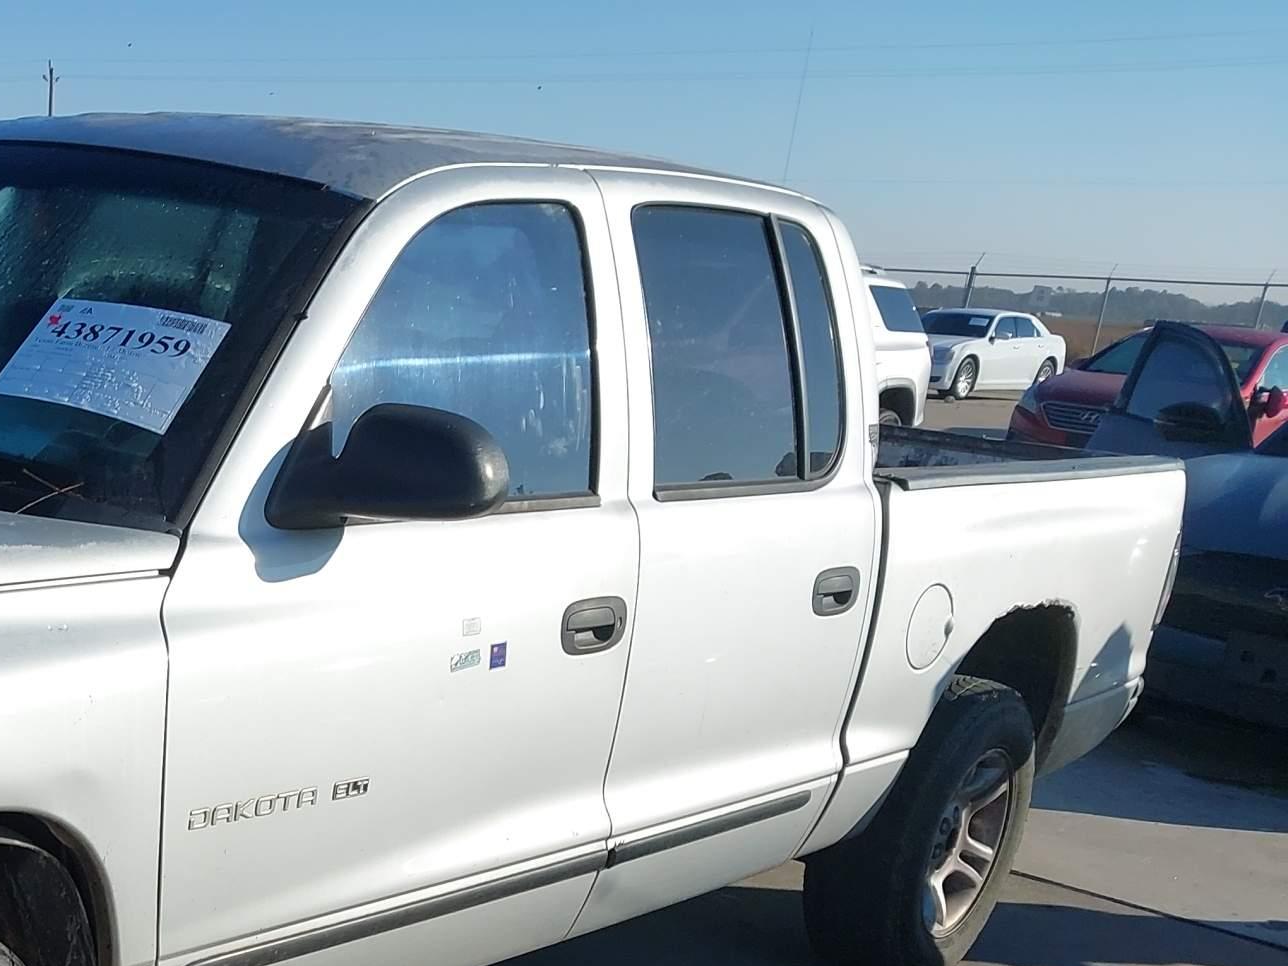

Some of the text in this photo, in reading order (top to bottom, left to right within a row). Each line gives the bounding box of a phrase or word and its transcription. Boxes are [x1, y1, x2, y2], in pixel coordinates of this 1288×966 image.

[50, 320, 192, 358] 43871959
[187, 777, 370, 831] DAKOTA SLT
